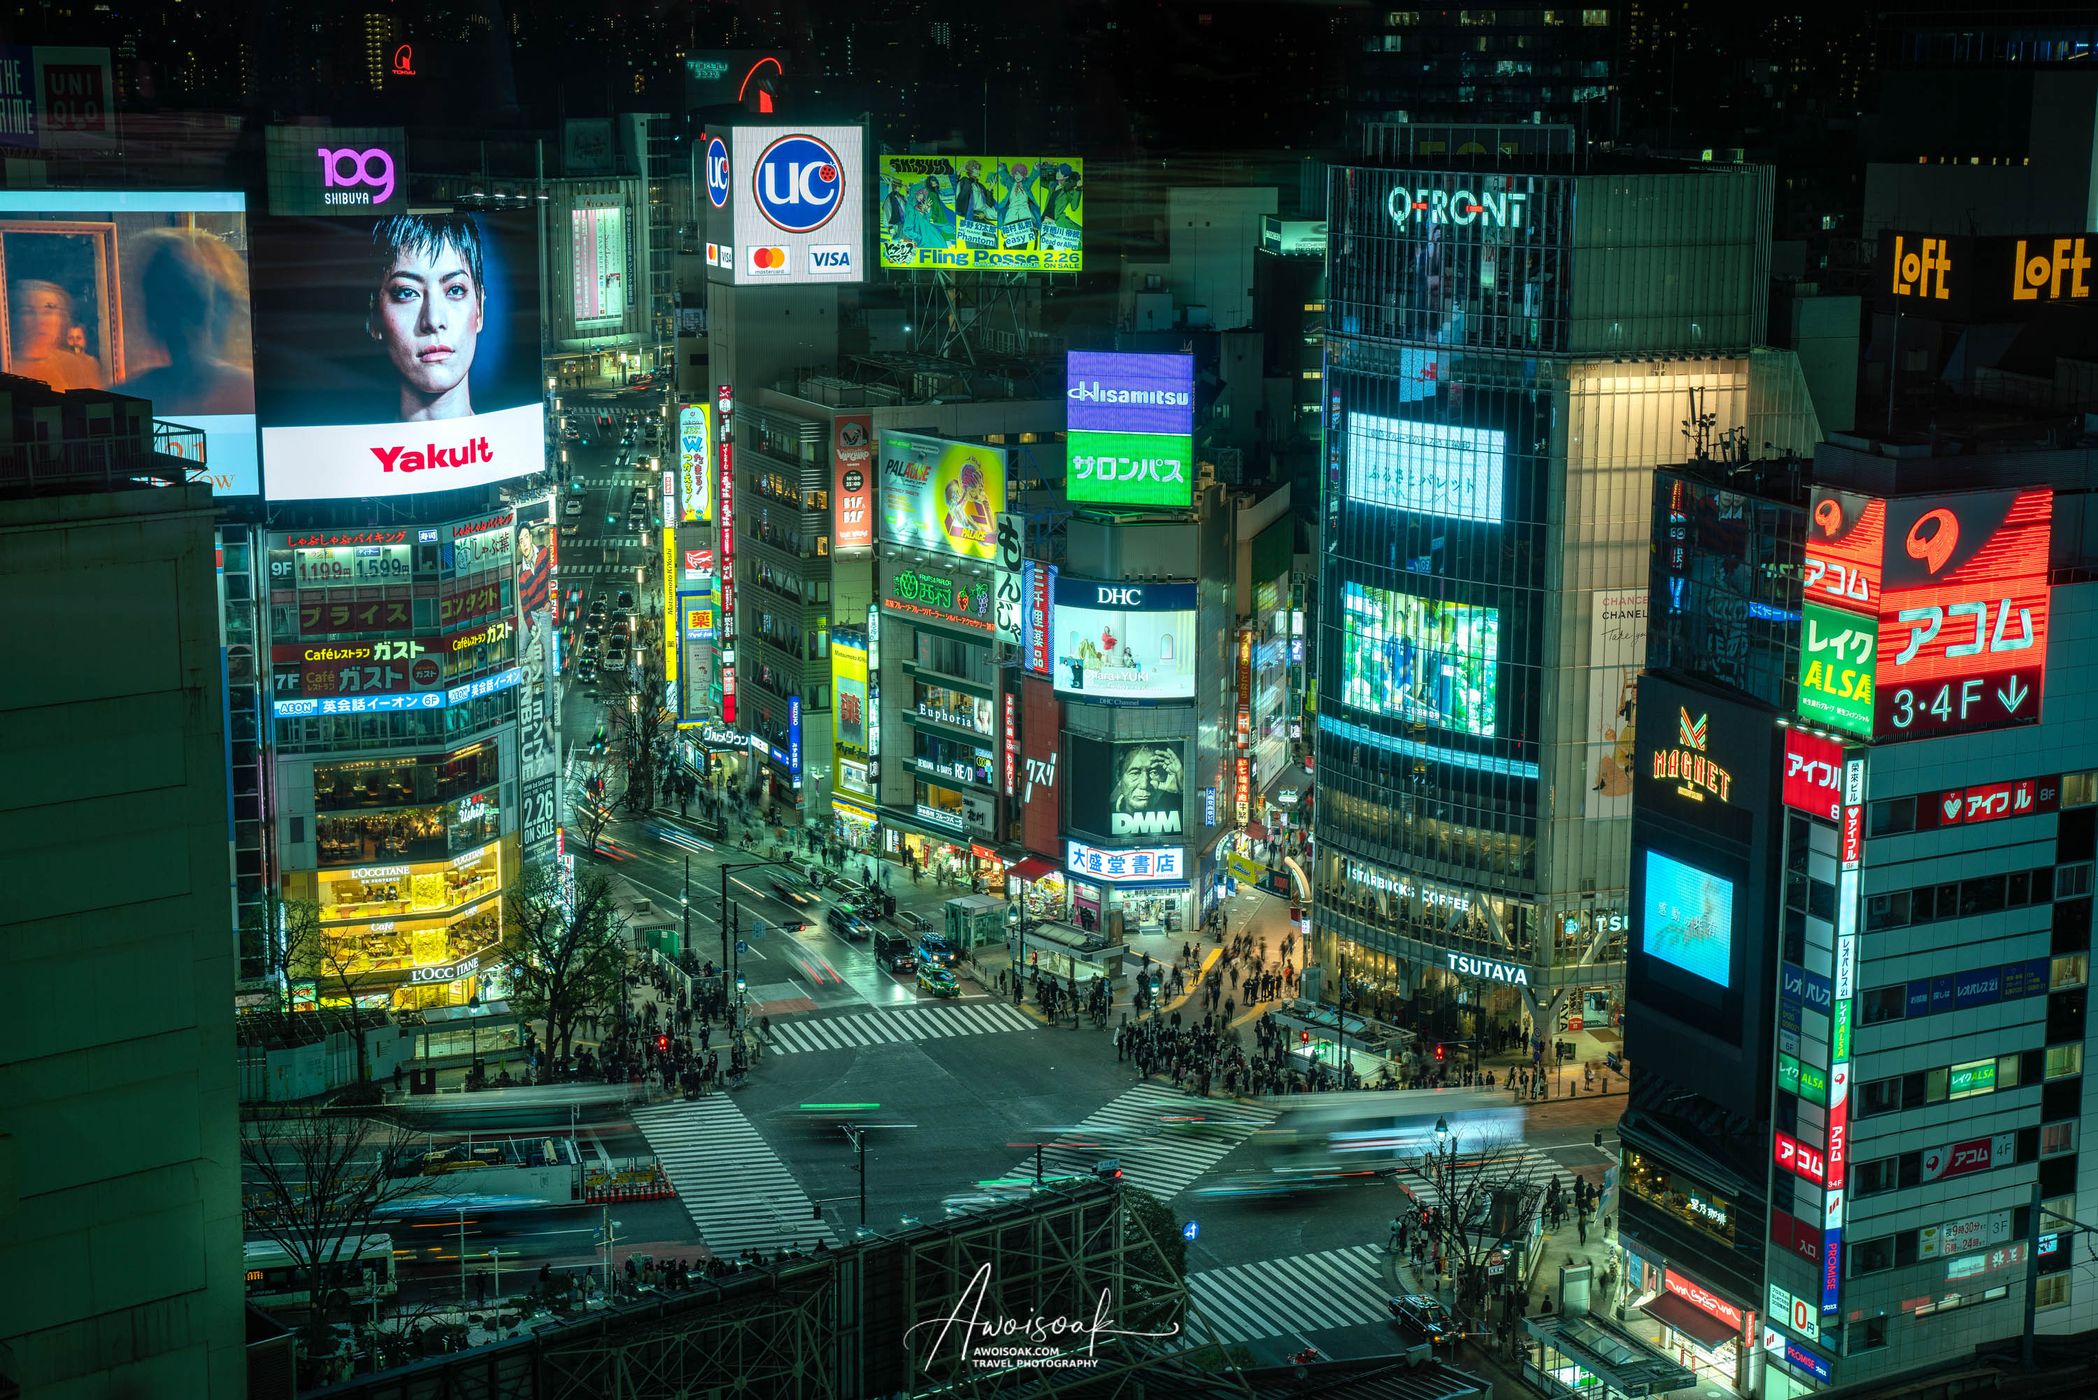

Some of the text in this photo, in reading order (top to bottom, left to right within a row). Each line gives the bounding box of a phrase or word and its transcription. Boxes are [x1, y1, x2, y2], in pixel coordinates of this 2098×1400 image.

[317, 148, 395, 204] 109
[324, 192, 369, 205] SHIBUYA
[1388, 186, 1526, 232] QFRONT
[957, 231, 995, 246] Phantom
[1006, 232, 1035, 245] easy R
[1041, 237, 1056, 246] Dead
[811, 252, 850, 267] VISA
[919, 249, 1040, 266] Fling Posse
[1043, 252, 1080, 263] 2.26
[1067, 381, 1189, 406] Hisamitsu
[370, 436, 494, 473] Yakult
[1072, 455, 1184, 483] サロンパス
[287, 530, 407, 547] しゃぶしゃぶバイキング
[474, 531, 510, 561] しゃぶ葉
[271, 561, 292, 576] 9F
[997, 516, 1022, 643] もんじゃ
[1804, 558, 1869, 601] アコム
[441, 586, 498, 620] コンタクト
[1097, 587, 1142, 605] DHC
[301, 603, 408, 628] プライス
[692, 611, 710, 628] 薬
[1033, 567, 1045, 669] 三千里薬品
[1602, 610, 1648, 620] CHANEL
[486, 621, 513, 644] ガスト
[1808, 619, 1874, 665] レイク
[1896, 598, 2034, 665] アコム
[373, 641, 425, 661] ガスト
[274, 673, 300, 690] 7F
[305, 670, 335, 684] Café
[338, 665, 404, 692] ガスト
[415, 670, 437, 679] ガスト
[471, 672, 521, 697] 英会話イーオン
[1804, 660, 1872, 705] ALSA
[279, 702, 313, 714] AEON
[322, 696, 418, 713] 英会話イーオン
[424, 695, 438, 706] 6F
[520, 665, 534, 782] CNBLUE
[920, 703, 972, 727] Euphoria
[703, 727, 749, 746] グルメタウン
[1024, 752, 1057, 803] クスリ
[1653, 749, 1733, 803] MAGNET
[1967, 788, 2031, 817] アイフル
[2039, 787, 2056, 801] 8F
[524, 789, 554, 829] 2.26
[524, 819, 555, 845] ON SALE
[1111, 811, 1182, 835] DMM
[1846, 819, 1857, 861] アイフル
[351, 866, 410, 879] L'OCCITANE
[1073, 848, 1175, 875] 大盛堂書店
[1351, 867, 1470, 912] STARBUCKS COFFEE
[370, 922, 394, 932] Café
[1447, 953, 1527, 985] TSUTAYA
[1840, 938, 1850, 996] レオパレス21
[1779, 1061, 1824, 1090] レイク ALSA
[1831, 1126, 1843, 1163] アコム
[1996, 1142, 2012, 1156] 4F
[1781, 1140, 1824, 1176] アコム
[1955, 1148, 1989, 1167] アコム
[1993, 1219, 2008, 1235] 3F
[1799, 1239, 1817, 1257] 入口
[1827, 1243, 1838, 1291] PROMISE
[1794, 1300, 1815, 1335] 0円
[1823, 1303, 1837, 1311] プロミス
[1787, 1346, 1815, 1369] PROMISE
